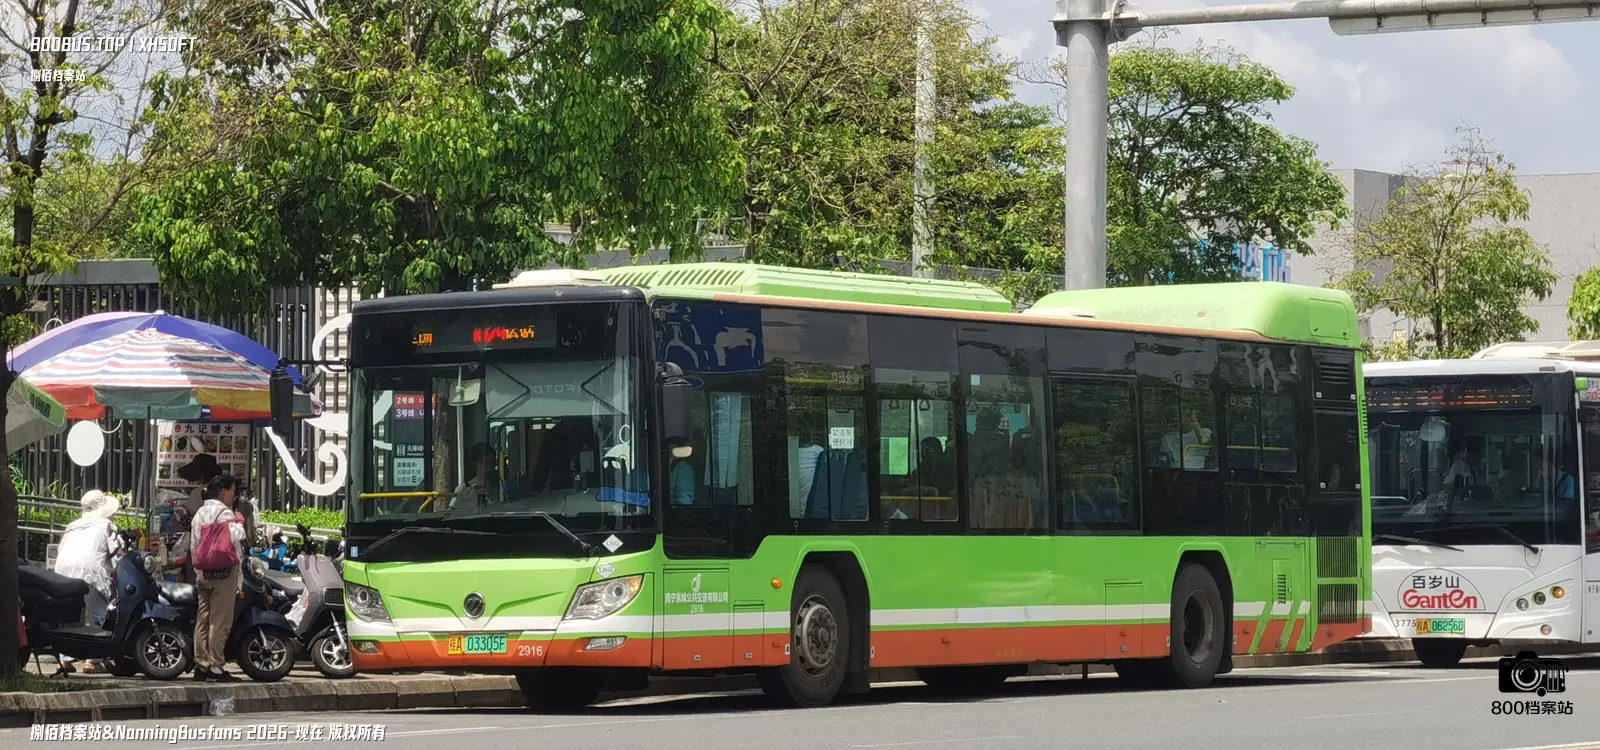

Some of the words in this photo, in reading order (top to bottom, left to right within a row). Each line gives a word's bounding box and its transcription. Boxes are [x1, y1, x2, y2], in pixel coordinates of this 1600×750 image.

[185, 423, 234, 434] 九记糖水
[1412, 575, 1460, 589] 百岁山
[690, 603, 704, 614] 2916
[1395, 619, 1416, 628] 3775
[467, 635, 506, 651] 03305F
[518, 645, 543, 657] 2916
